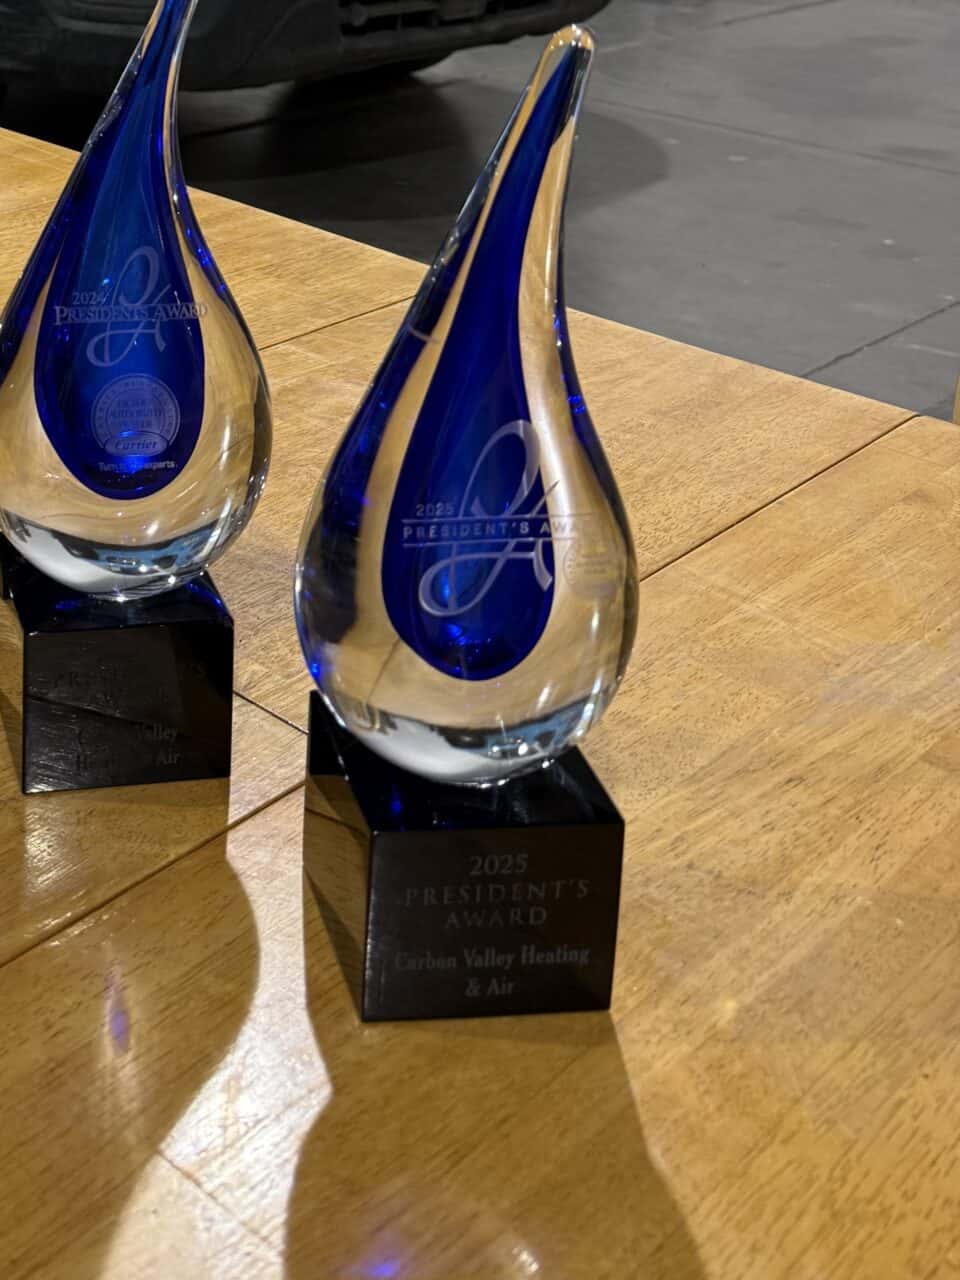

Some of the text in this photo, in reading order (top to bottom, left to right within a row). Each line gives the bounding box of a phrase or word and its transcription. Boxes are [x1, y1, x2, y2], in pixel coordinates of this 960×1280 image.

[415, 503, 454, 517] 2025
[403, 520, 530, 539] PRESIDENT'S
[469, 854, 529, 877] 2025
[404, 879, 591, 907] PRESIDENT'S
[445, 906, 548, 929] AWARD
[394, 943, 592, 971] Carbon Valley Heating
[465, 976, 518, 998] & Air
